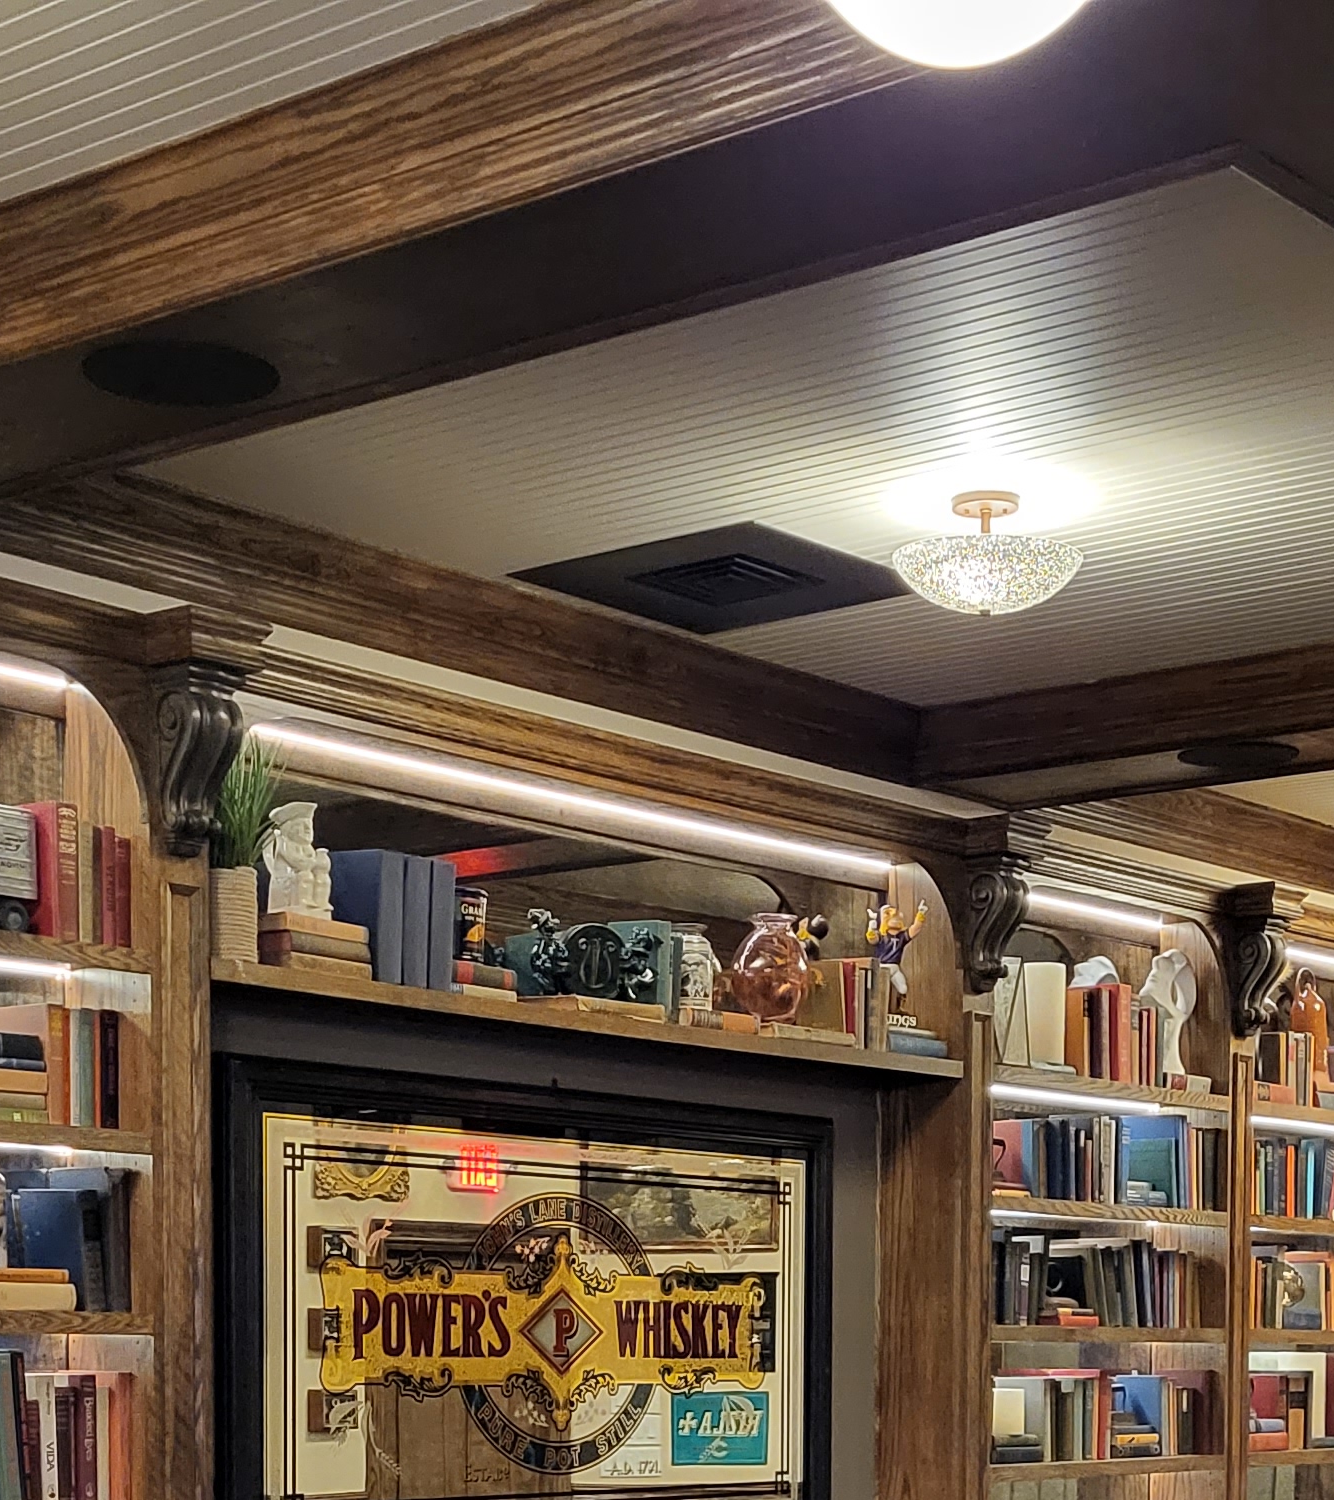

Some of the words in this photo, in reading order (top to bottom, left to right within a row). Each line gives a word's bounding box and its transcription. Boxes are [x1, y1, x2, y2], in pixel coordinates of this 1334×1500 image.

[478, 1208, 526, 1265] JOHN'S
[528, 1198, 567, 1223] LANE
[351, 1286, 512, 1362] POWER'S
[551, 1307, 579, 1357] P
[614, 1298, 746, 1362] WHISKEY
[46, 1441, 56, 1472] VIDA
[477, 1402, 529, 1459] PURE
[542, 1446, 582, 1469] POT
[595, 1403, 643, 1456] STILL
